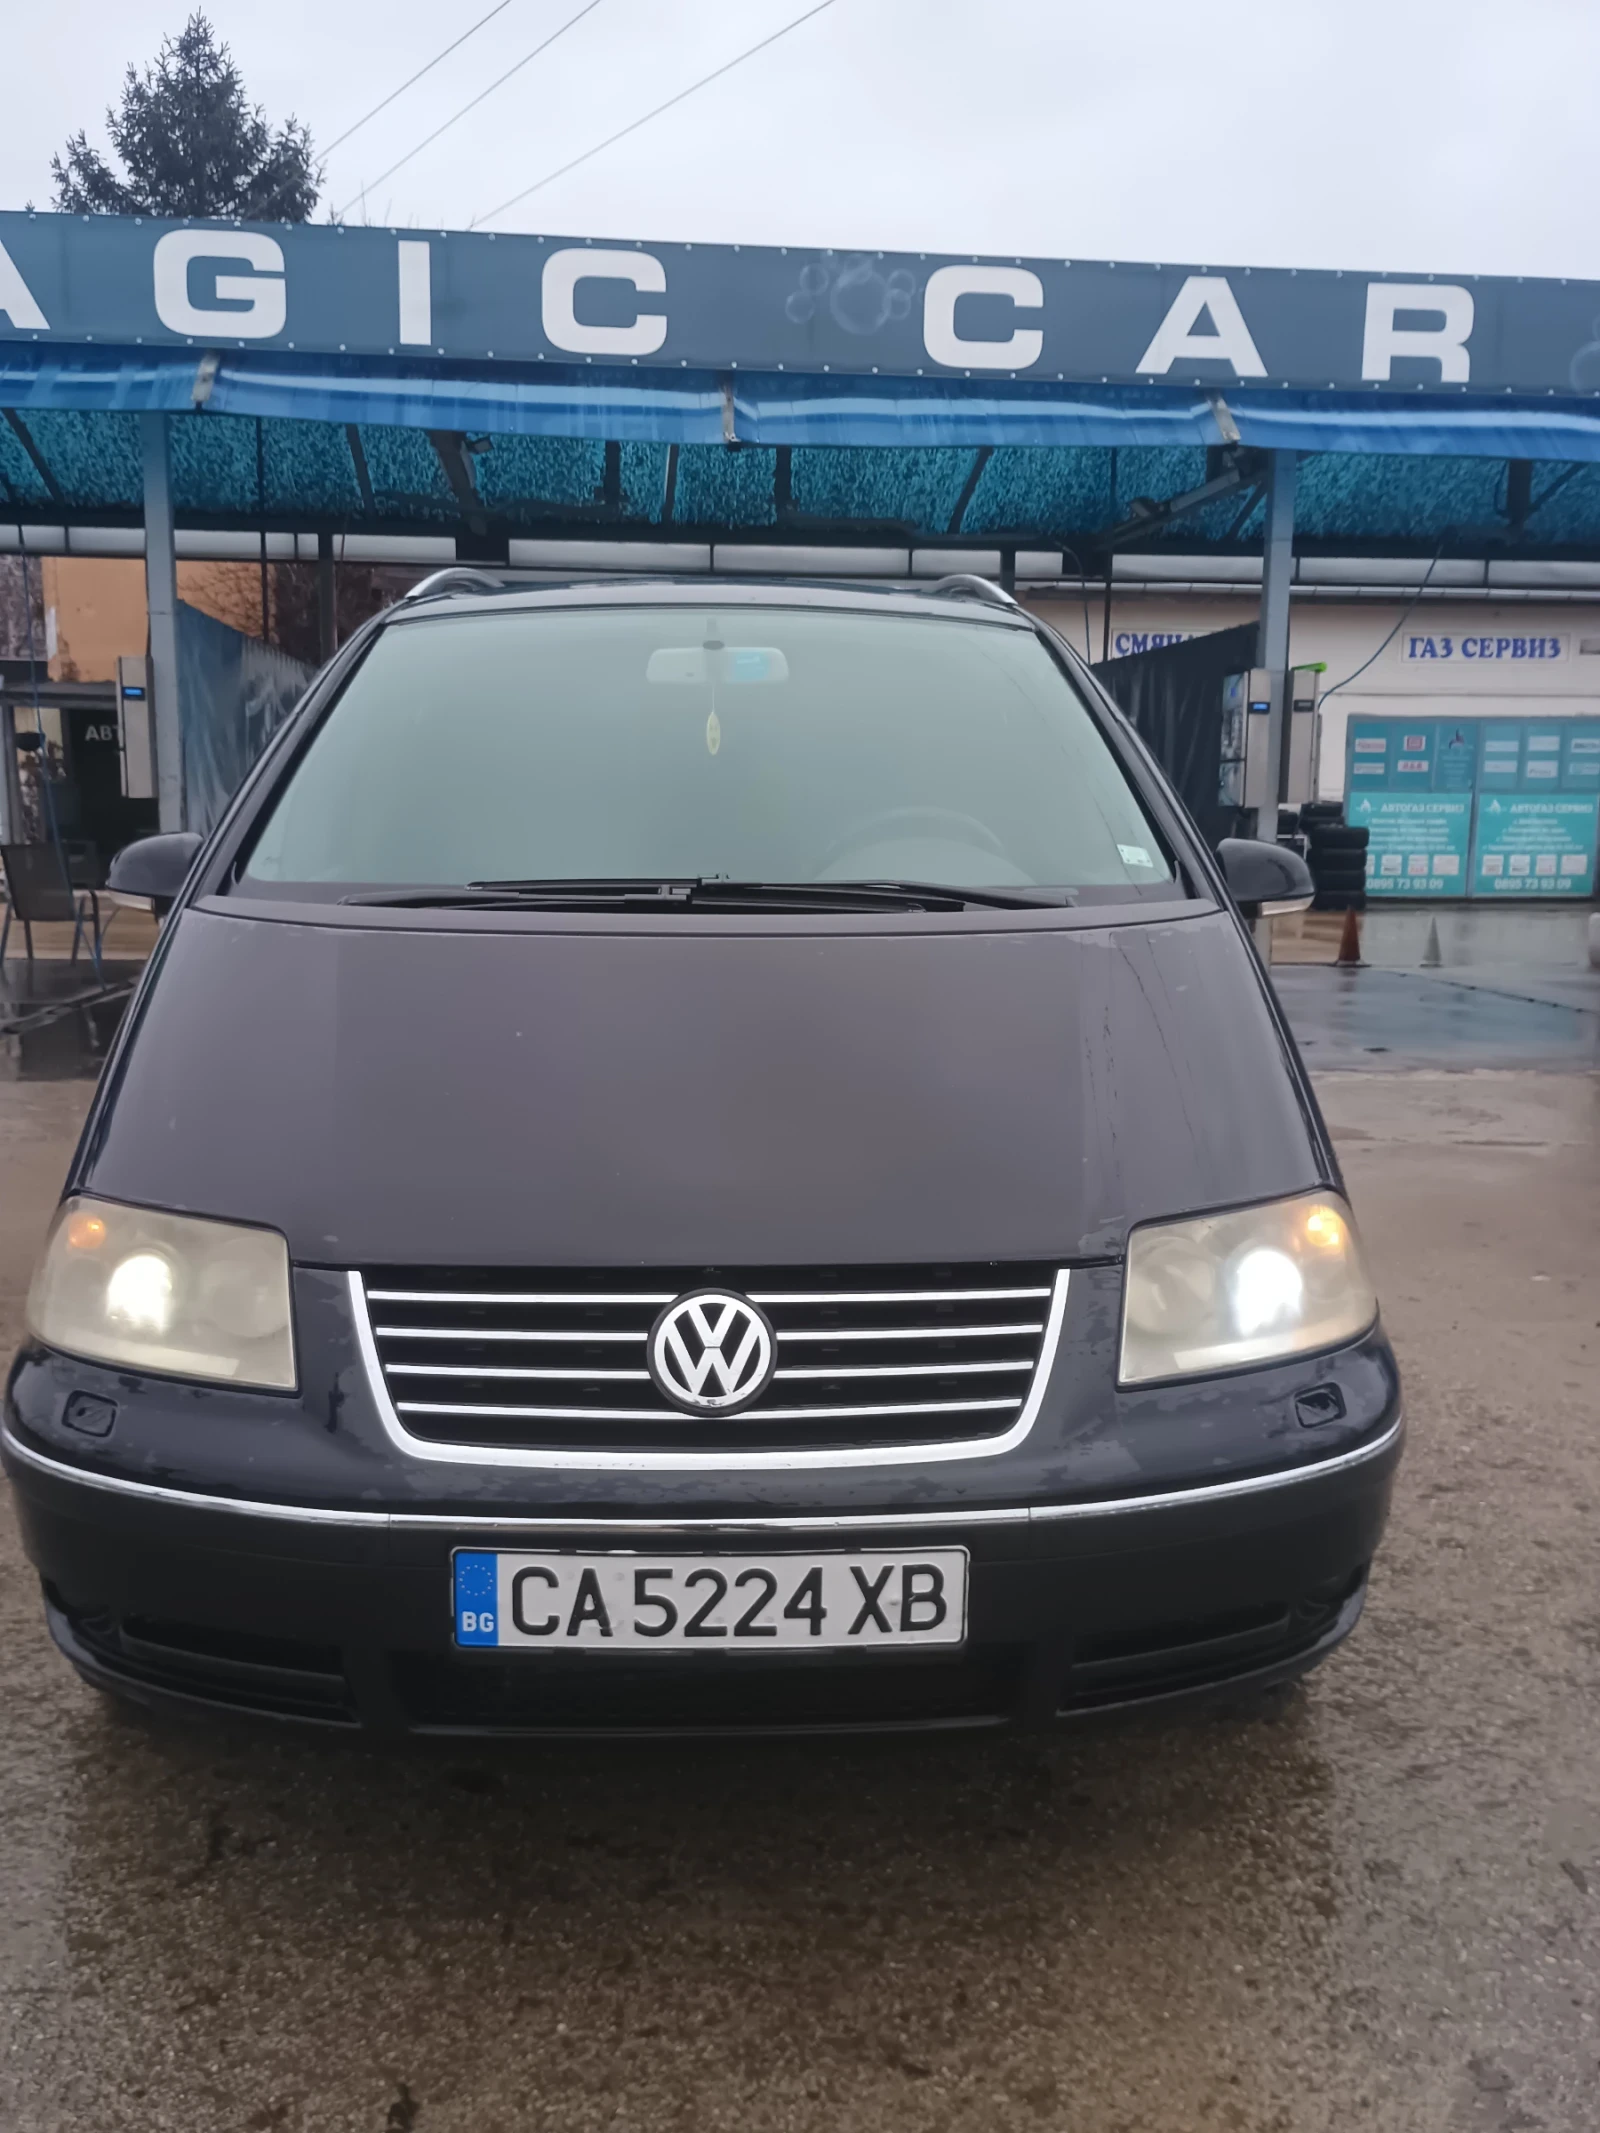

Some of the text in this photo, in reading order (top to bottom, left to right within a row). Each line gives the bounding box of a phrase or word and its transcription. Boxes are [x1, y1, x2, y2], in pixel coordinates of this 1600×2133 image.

[923, 264, 1475, 383] CAR
[1115, 633, 1194, 656] СМЯ
[1408, 637, 1561, 659] ГАЗ СЕРВИЗ
[657, 1296, 768, 1403] VW
[462, 1611, 494, 1632] BG
[512, 1563, 947, 1637] CA 5224 XB
